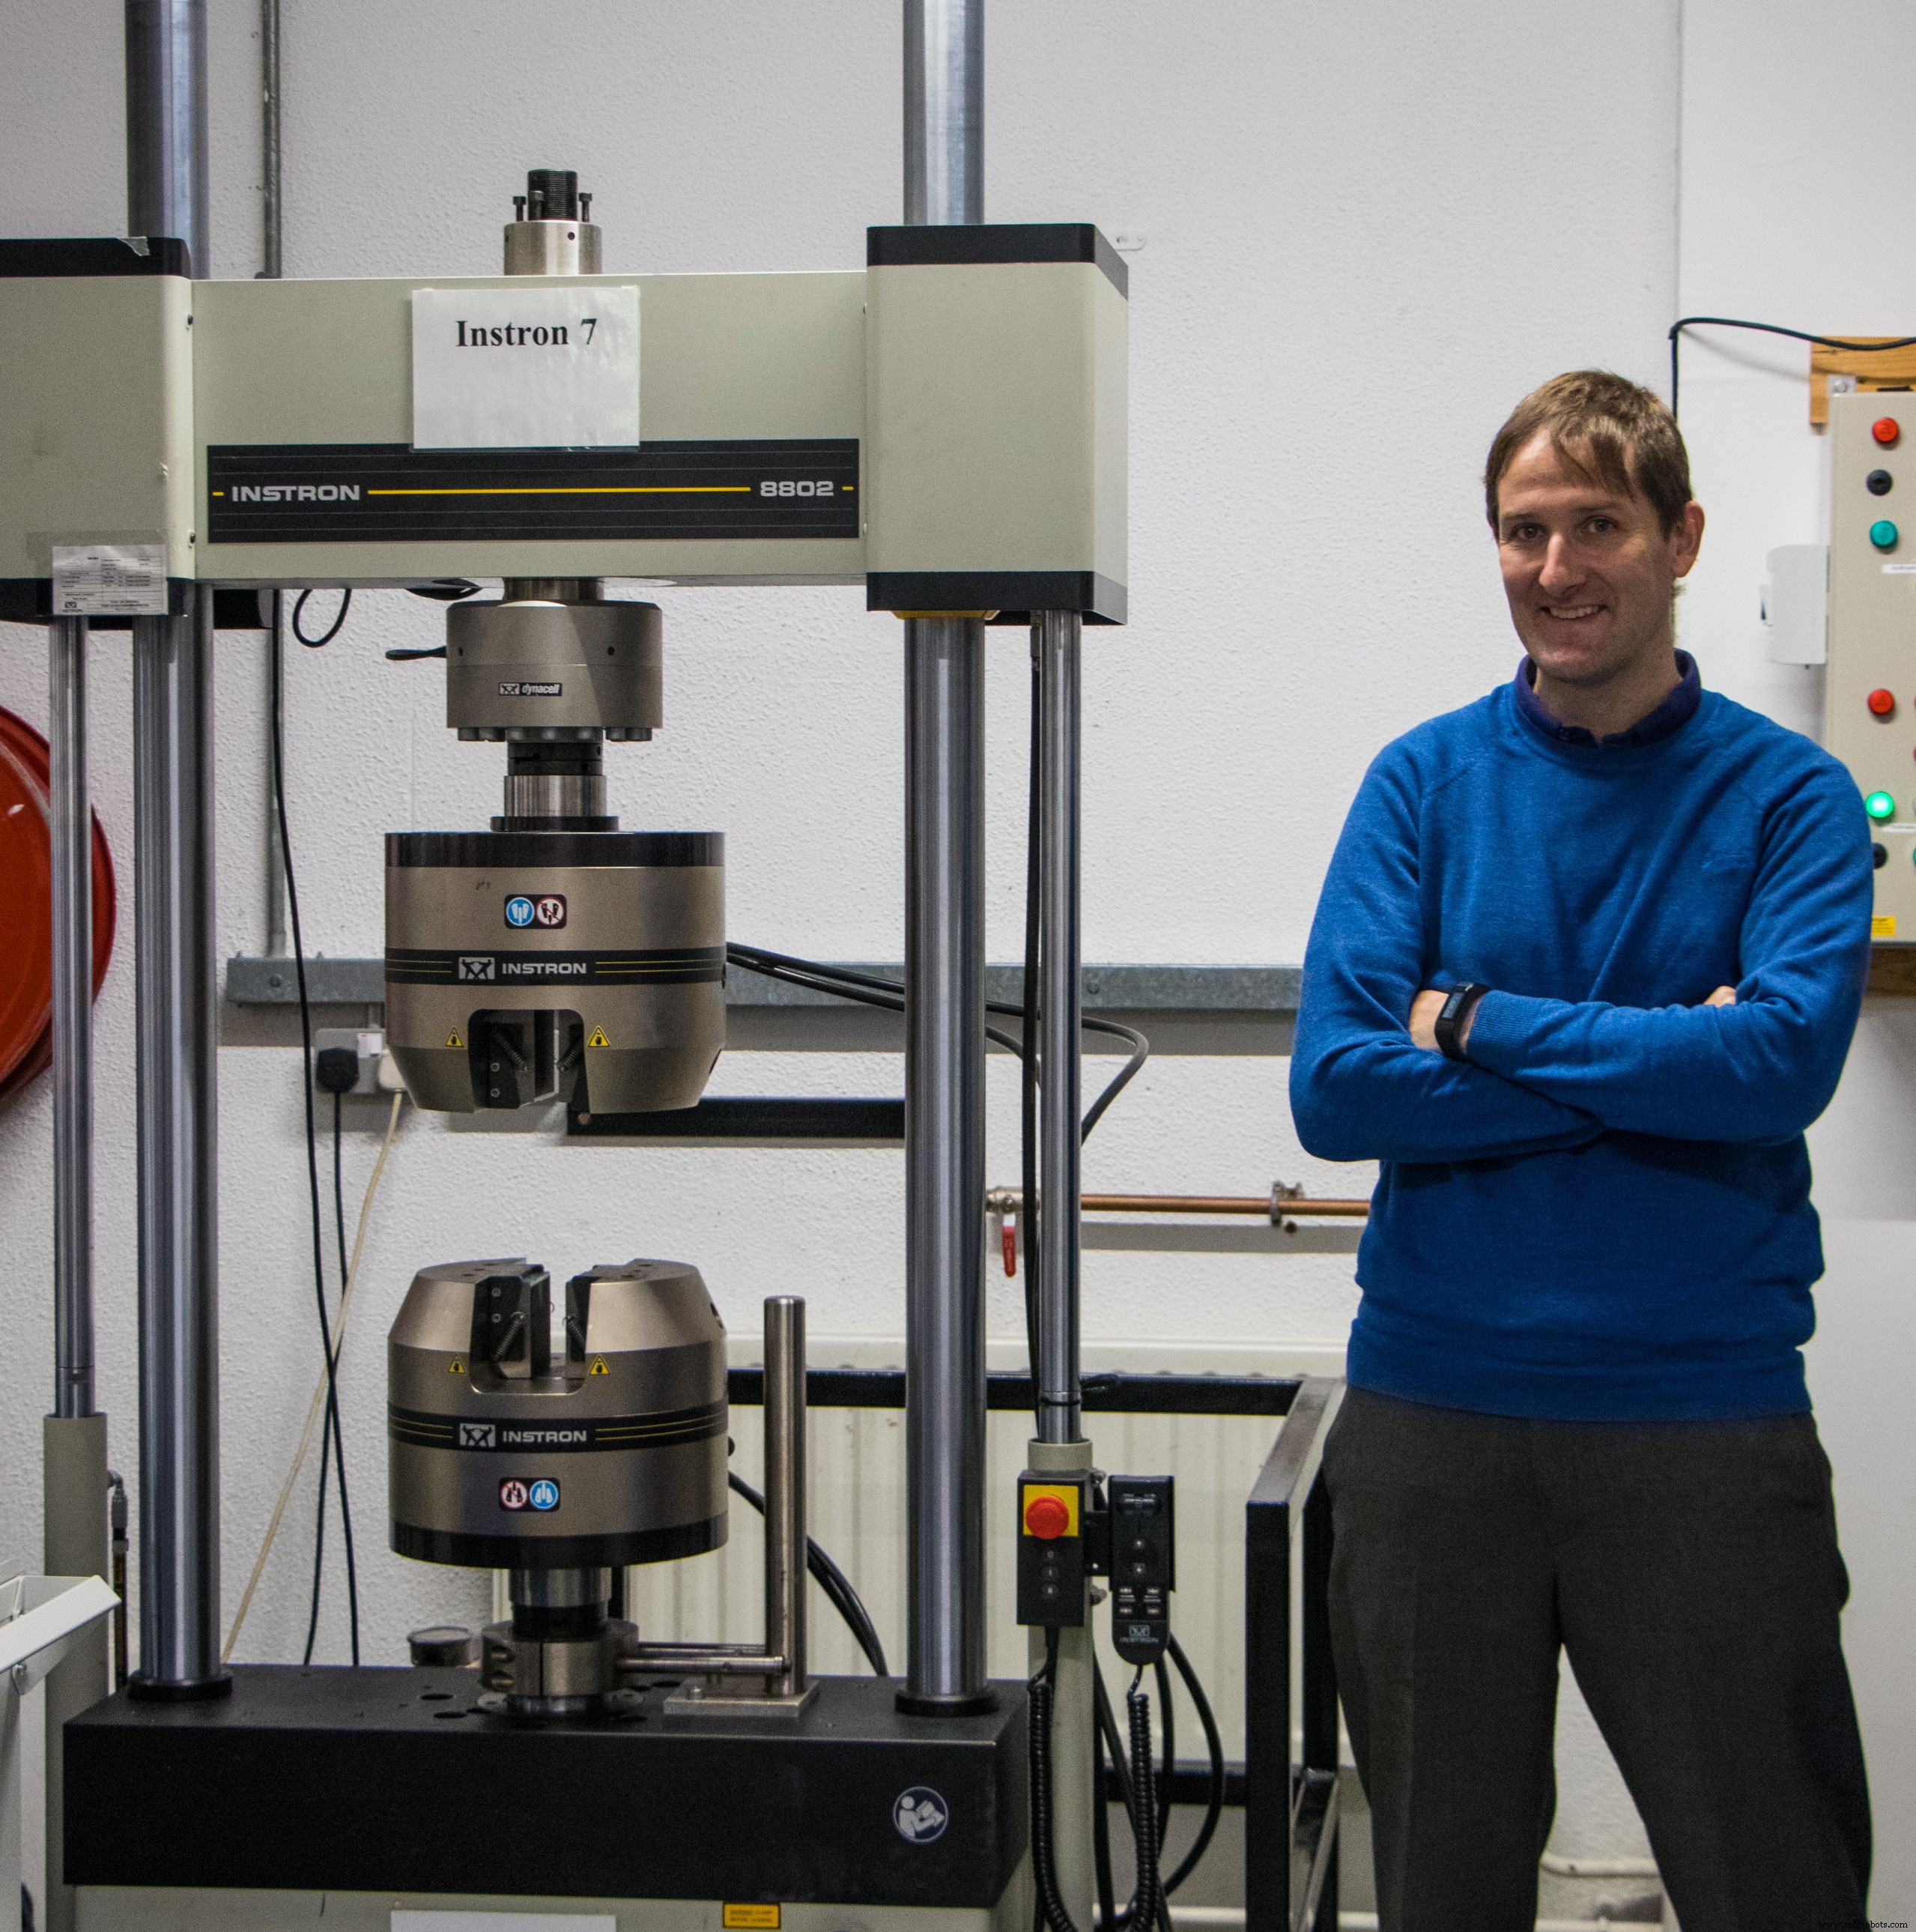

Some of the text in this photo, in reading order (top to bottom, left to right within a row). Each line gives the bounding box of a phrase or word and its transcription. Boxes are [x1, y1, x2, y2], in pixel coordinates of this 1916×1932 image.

[455, 318, 597, 347] Instron 7
[232, 480, 834, 501] INSTRON 8802
[521, 683, 560, 695] dynacell
[502, 963, 587, 974] INSTRON
[503, 1430, 587, 1443] INSTRON
